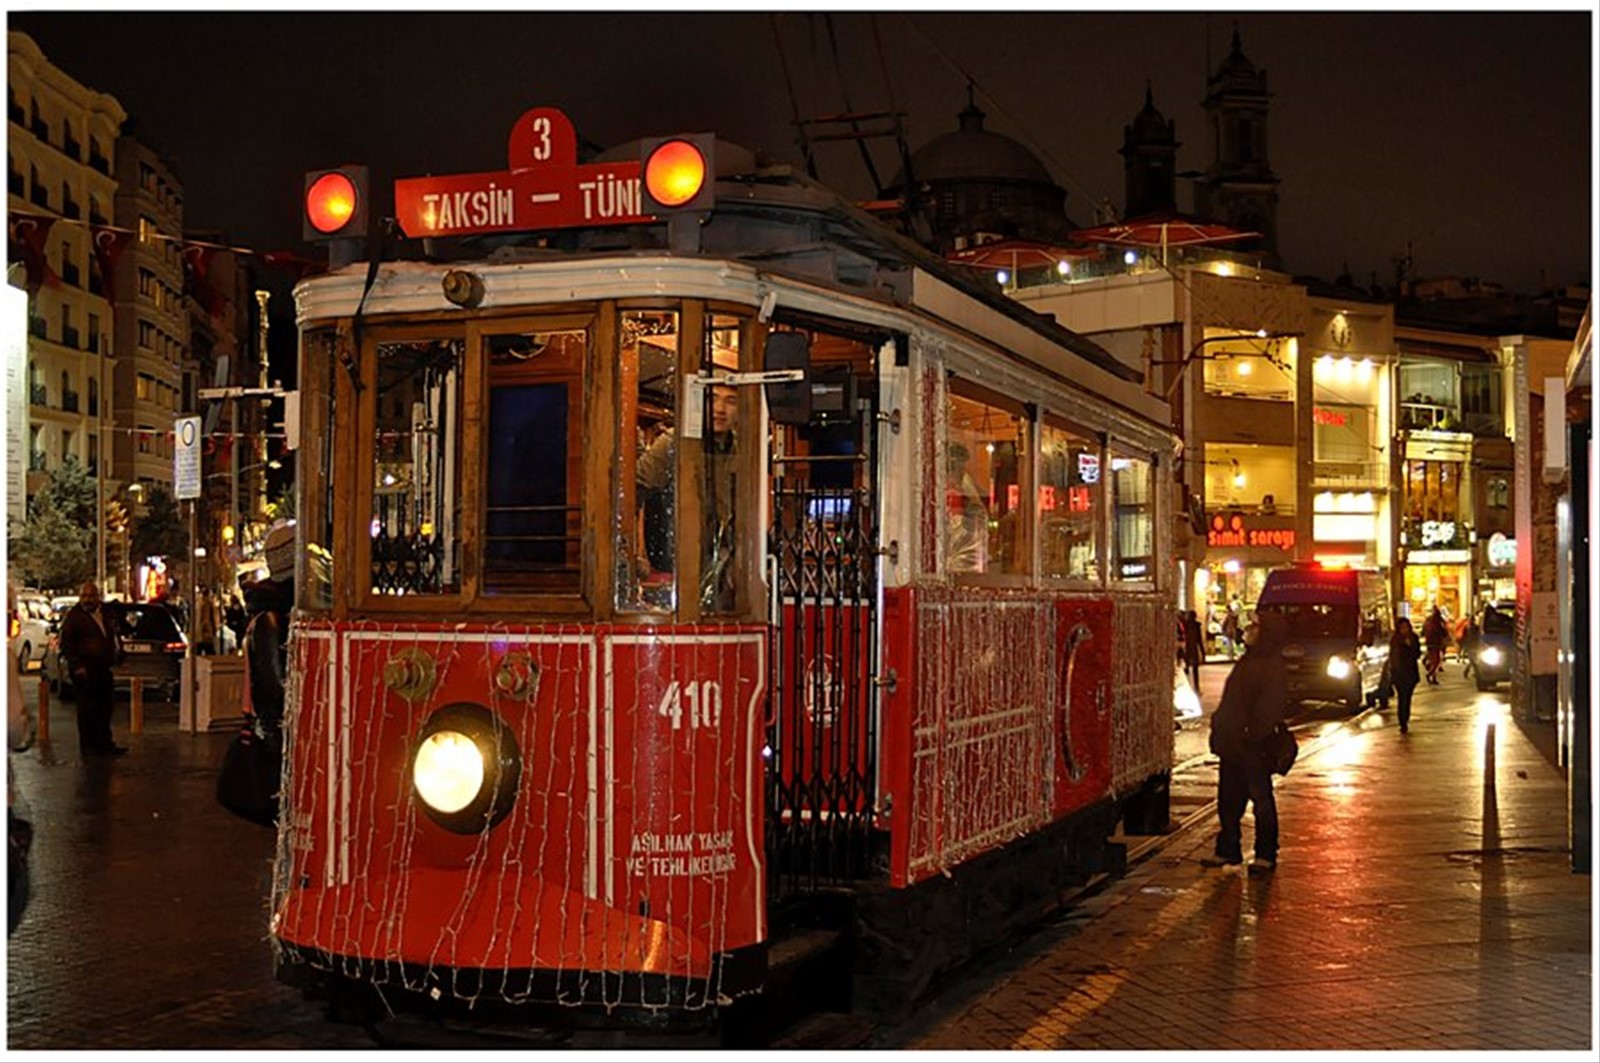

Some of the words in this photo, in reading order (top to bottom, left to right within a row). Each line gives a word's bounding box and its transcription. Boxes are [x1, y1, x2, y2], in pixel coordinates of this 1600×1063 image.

[533, 117, 551, 160] 3
[423, 183, 514, 230] TAKSİM
[1208, 516, 1245, 546] simit
[658, 680, 721, 729] 410
